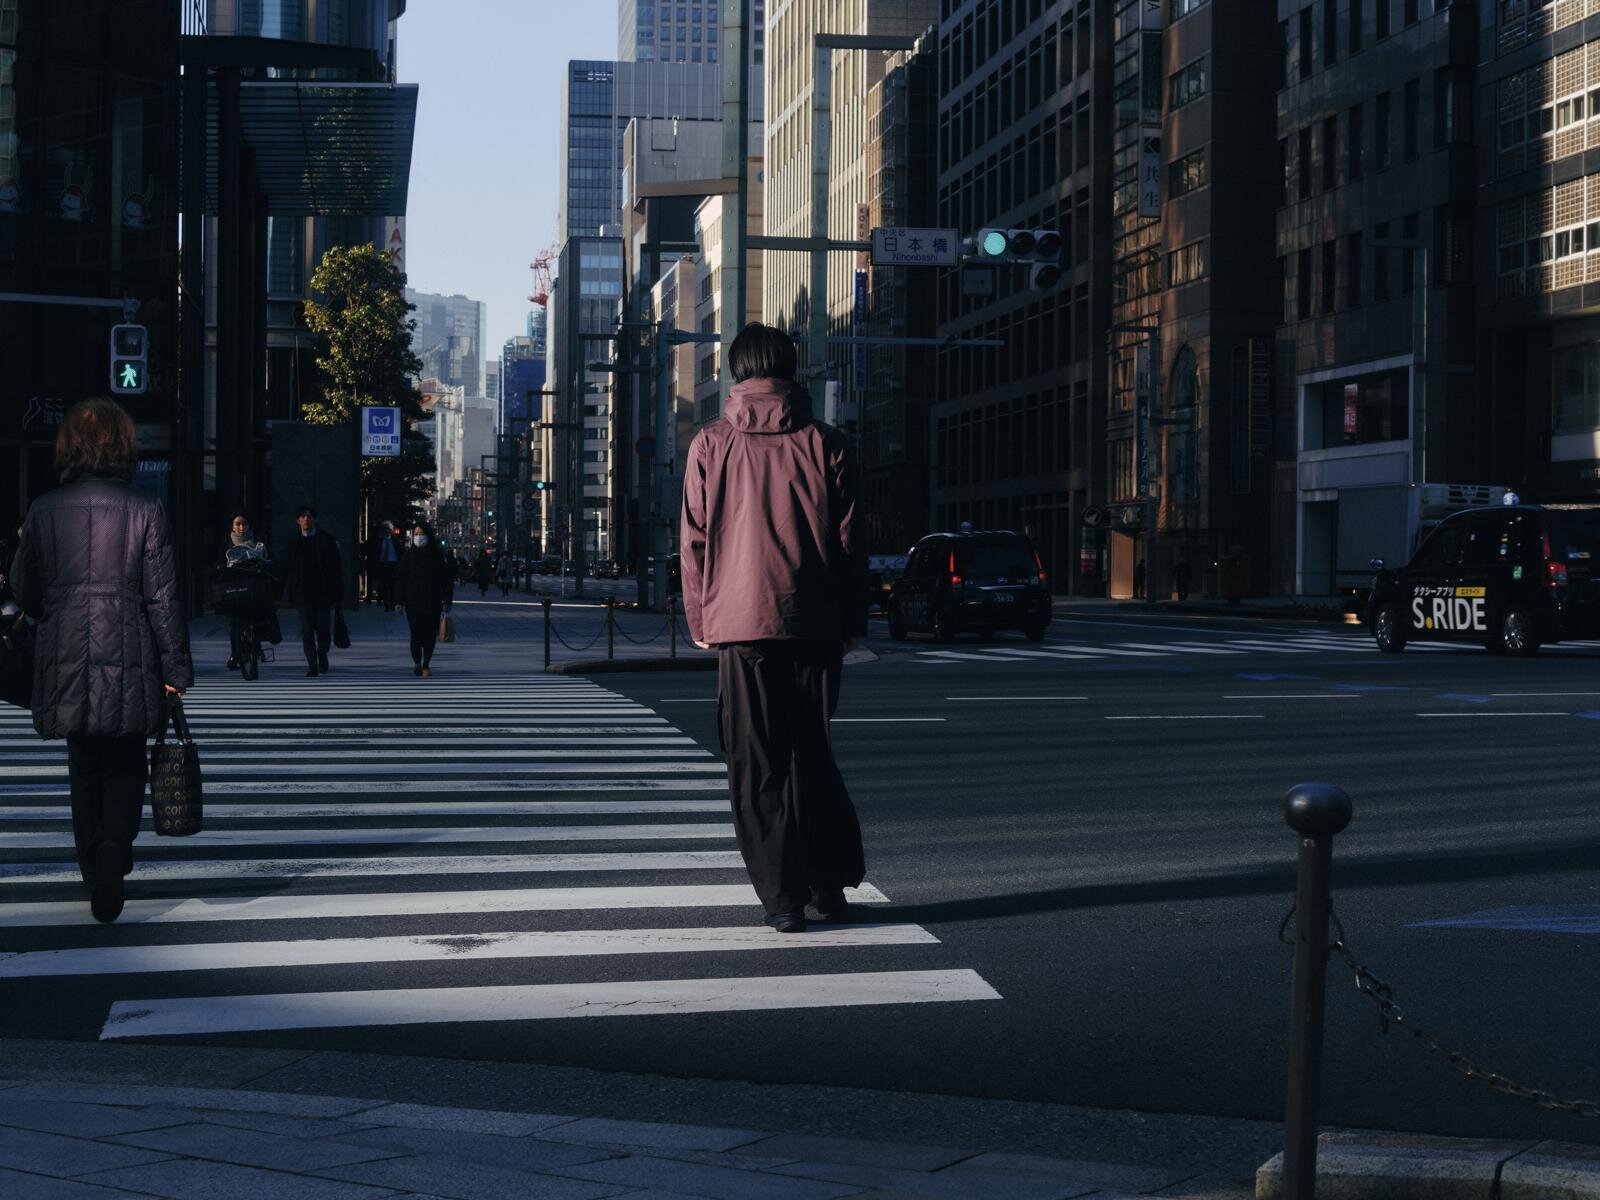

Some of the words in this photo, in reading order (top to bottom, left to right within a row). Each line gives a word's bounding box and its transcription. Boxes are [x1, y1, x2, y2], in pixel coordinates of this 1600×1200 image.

[1143, 165, 1160, 208] 共生
[885, 237, 948, 253] 日本橋
[892, 253, 938, 262] Nihonbashi
[1413, 586, 1455, 597] タクシーアプリ
[1412, 596, 1488, 631] S.RIDE
